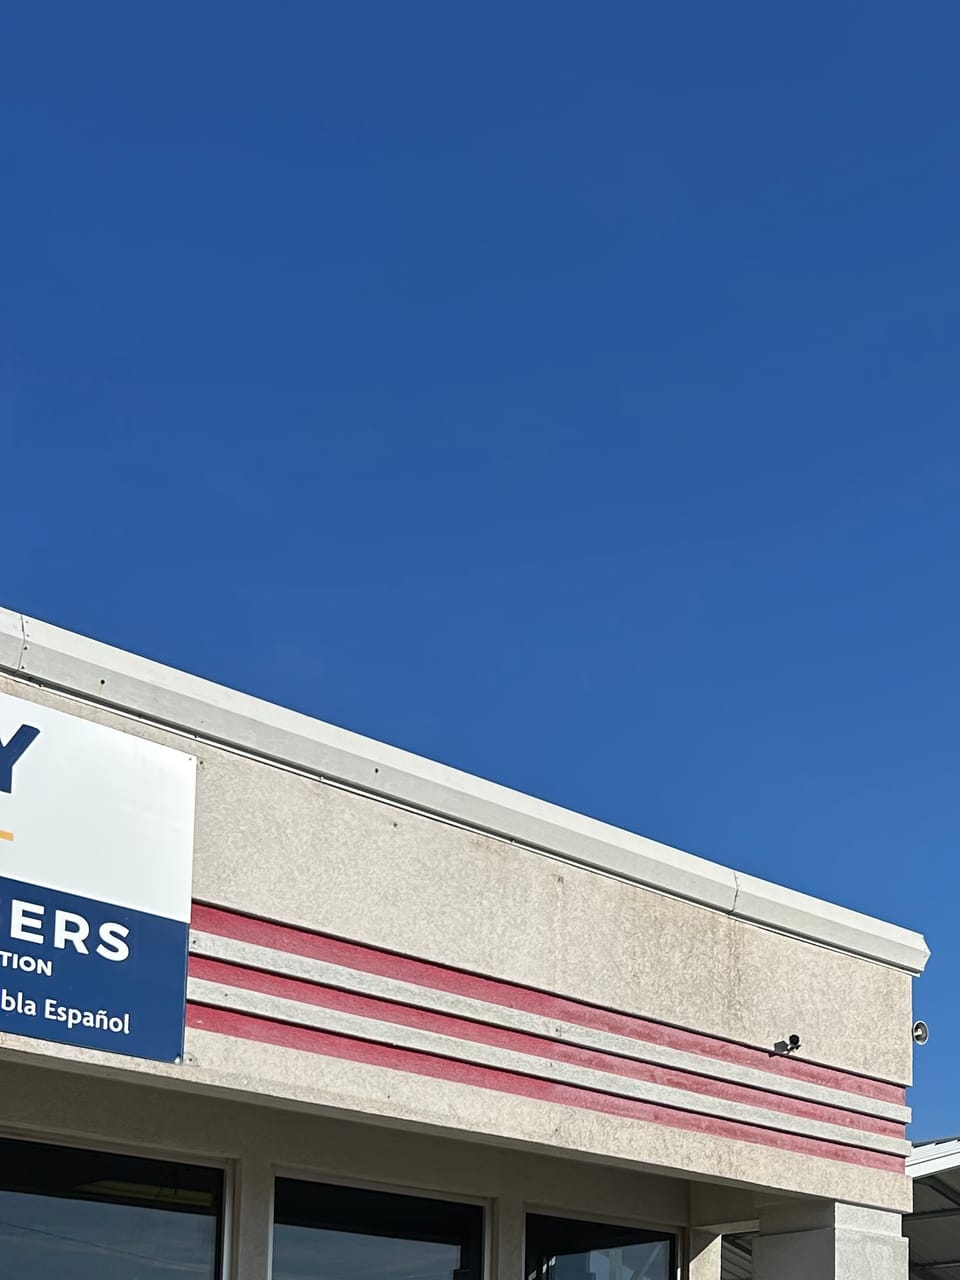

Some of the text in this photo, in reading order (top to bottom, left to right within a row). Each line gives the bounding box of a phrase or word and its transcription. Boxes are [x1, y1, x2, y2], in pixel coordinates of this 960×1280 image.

[0, 724, 41, 794] Y
[10, 899, 130, 962] ERS
[0, 950, 53, 976] TION
[1, 988, 130, 1034] bla Español
